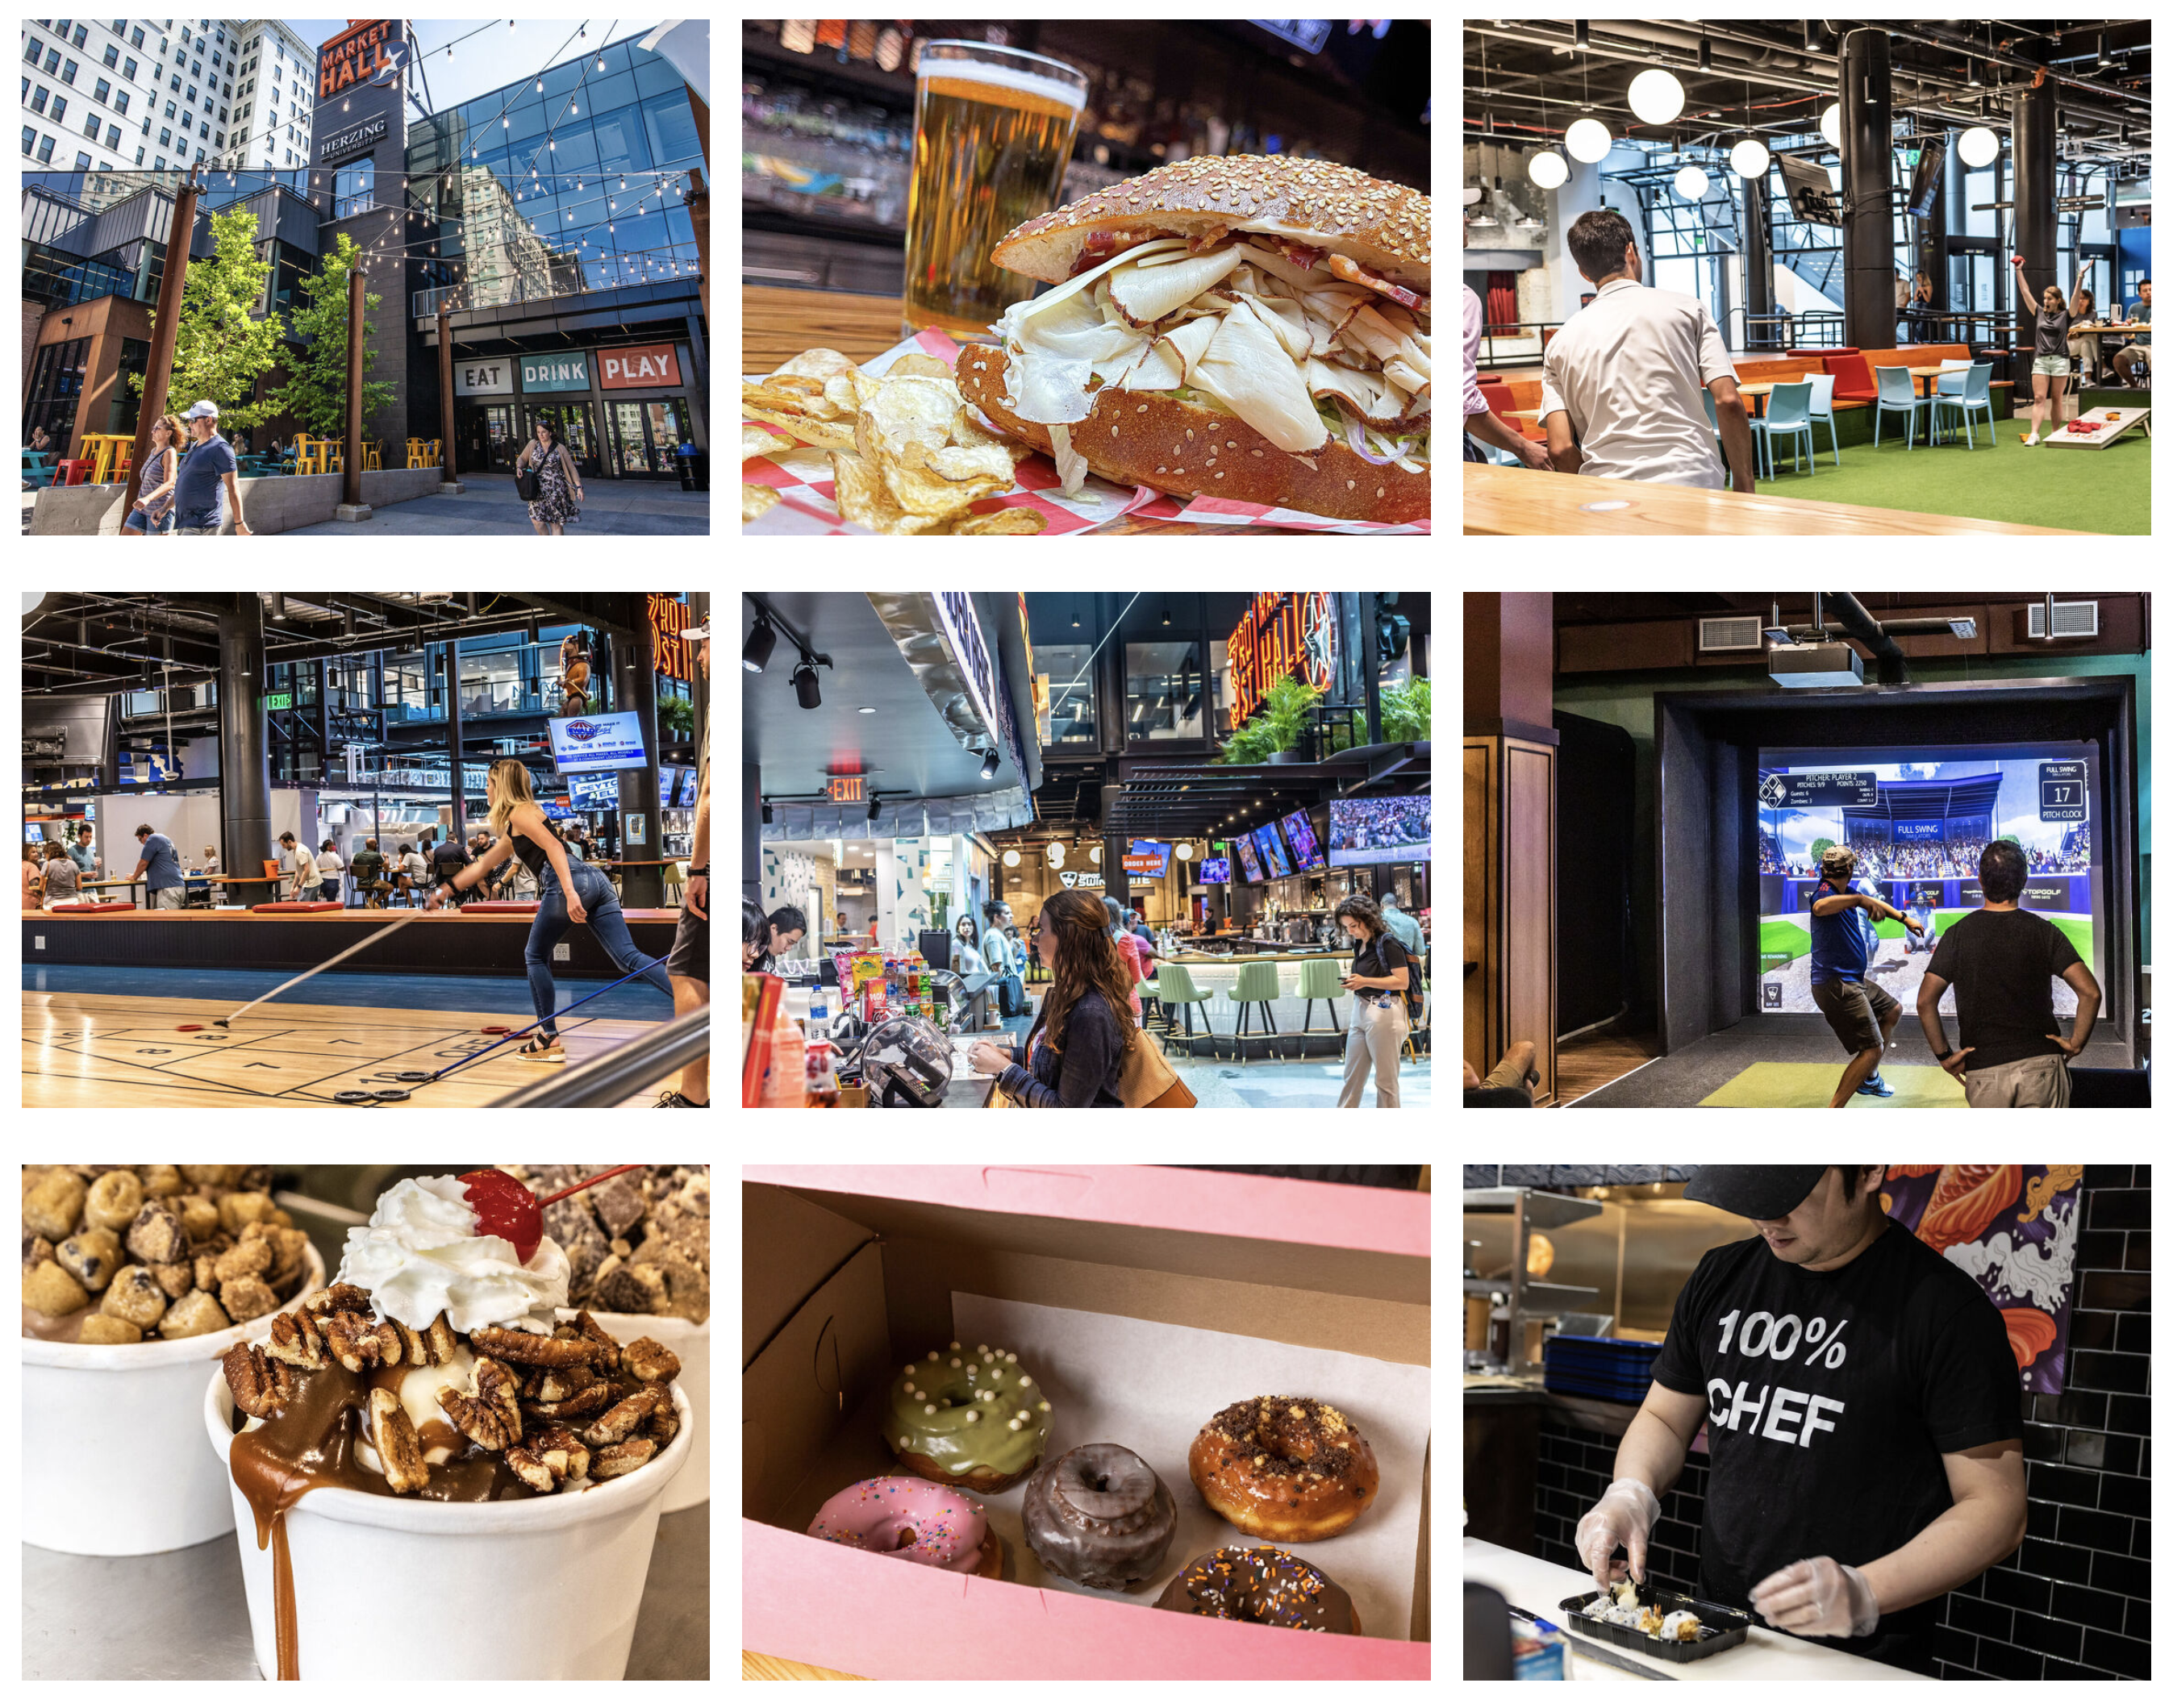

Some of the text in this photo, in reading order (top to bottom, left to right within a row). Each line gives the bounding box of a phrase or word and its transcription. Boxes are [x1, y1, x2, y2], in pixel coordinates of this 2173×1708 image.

[322, 21, 391, 71] MARKET
[319, 42, 391, 97] HALL
[321, 120, 386, 155] HERZING
[330, 136, 375, 158] UNIVERSITY
[465, 367, 500, 386] EAT
[525, 363, 585, 382] DRINK
[606, 354, 669, 379] PLAY
[1260, 592, 1307, 700] HALL
[272, 694, 287, 708] EXIT
[833, 777, 862, 801] EXIT
[2054, 787, 2071, 802] 17
[2043, 810, 2083, 819] PITCH CLOCK
[1898, 825, 1938, 834] FULL SWING
[1718, 1310, 1849, 1369] 100%
[1707, 1378, 1846, 1448] CHEF
